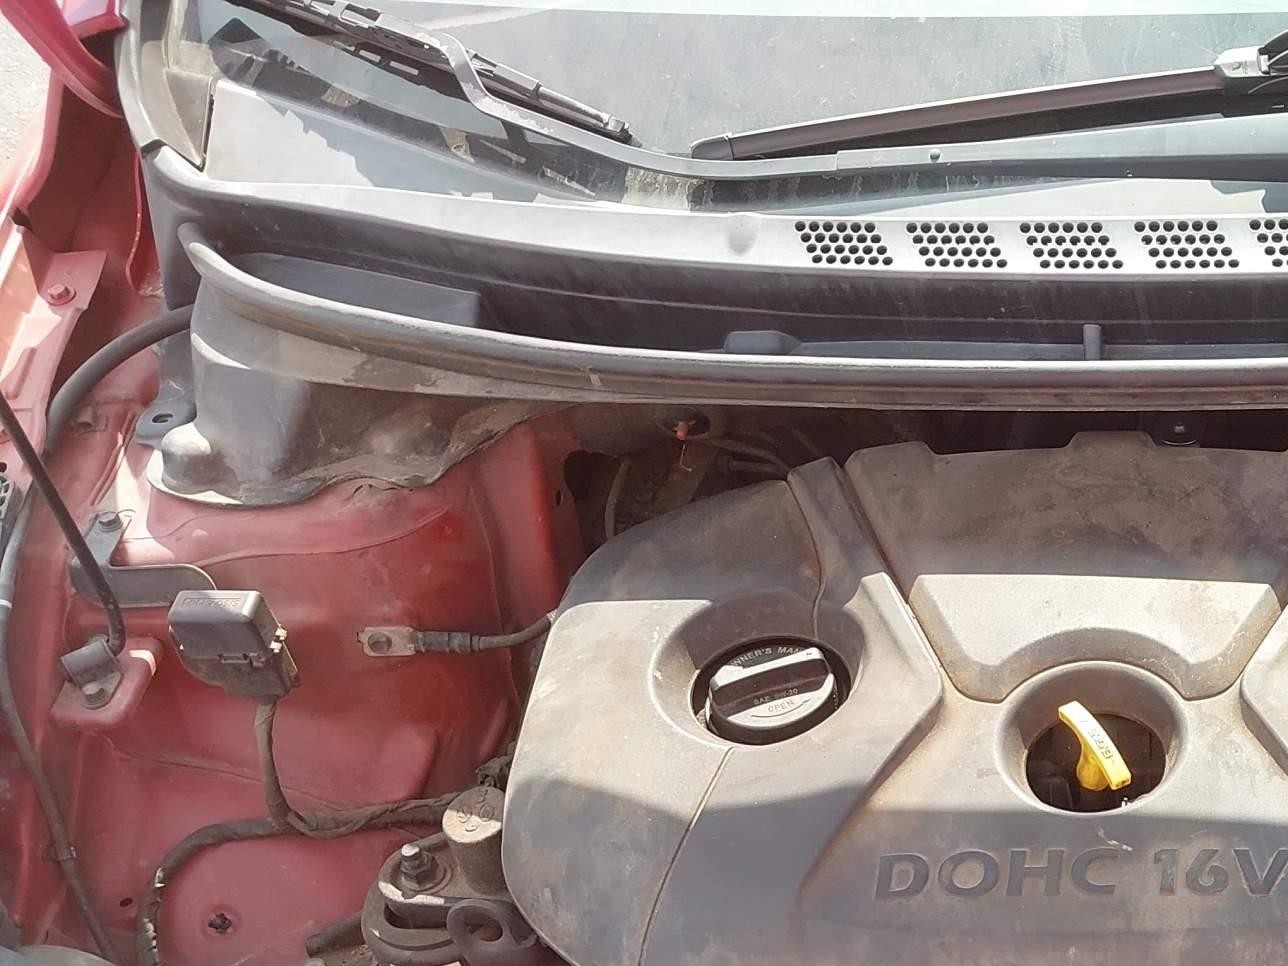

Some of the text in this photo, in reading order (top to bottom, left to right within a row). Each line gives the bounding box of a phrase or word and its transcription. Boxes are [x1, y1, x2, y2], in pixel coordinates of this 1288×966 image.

[730, 647, 772, 666] WNER'S
[767, 700, 794, 713] OPEN
[874, 847, 1121, 899] DOHC
